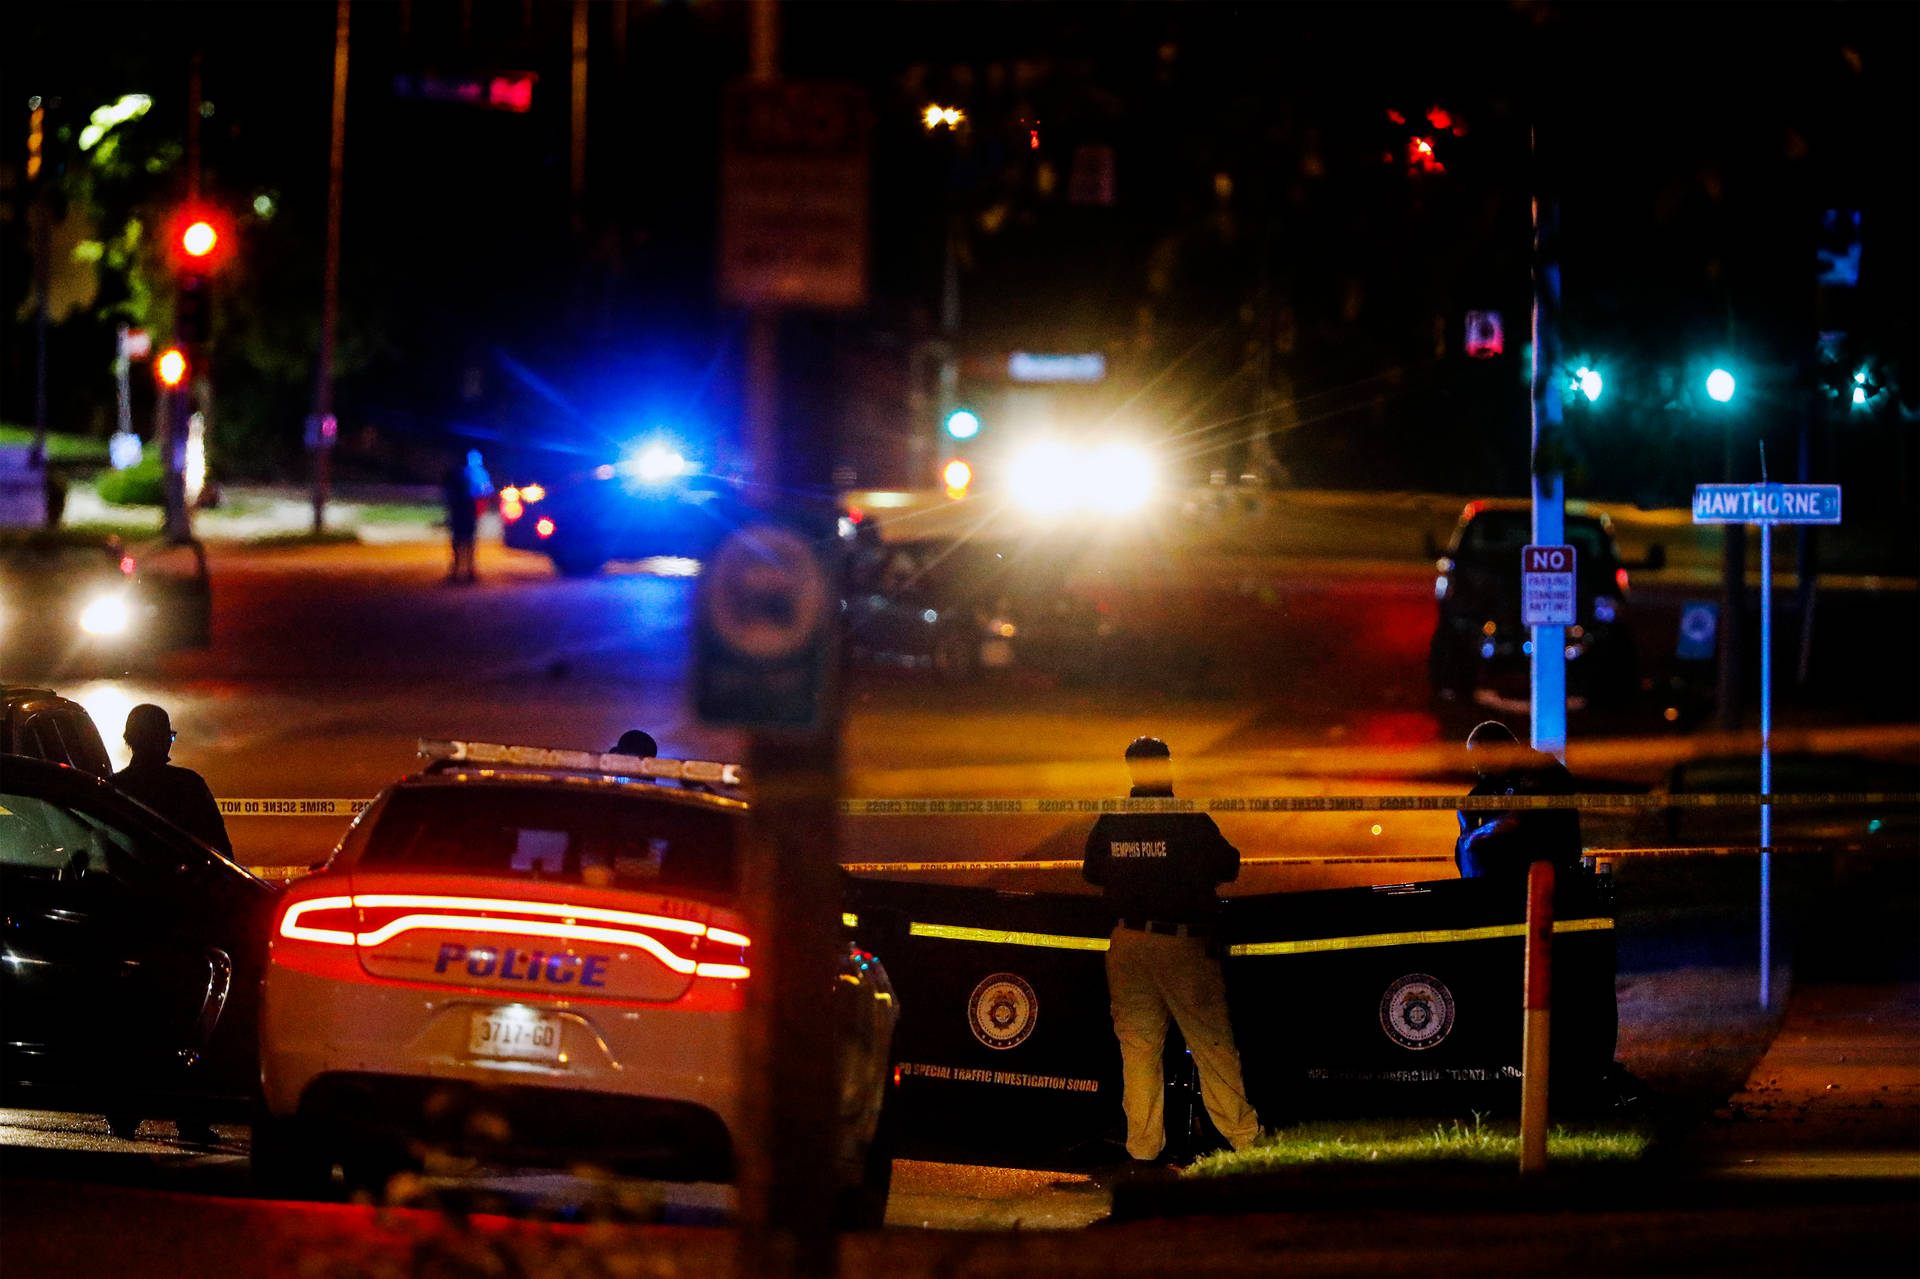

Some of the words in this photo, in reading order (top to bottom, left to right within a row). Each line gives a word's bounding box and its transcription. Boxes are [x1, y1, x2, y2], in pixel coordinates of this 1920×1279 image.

[1697, 491, 1821, 515] HAWTHORNE
[1532, 550, 1565, 569] NO
[1110, 840, 1140, 857] MEMPHIS
[1141, 840, 1167, 857] POLICE
[434, 941, 610, 988] POLICE
[913, 1063, 951, 1080] SPECIAL
[952, 1067, 993, 1083] TRAFFIC
[993, 1071, 1066, 1090] INVESTIGATION
[1066, 1078, 1100, 1093] SQUAD
